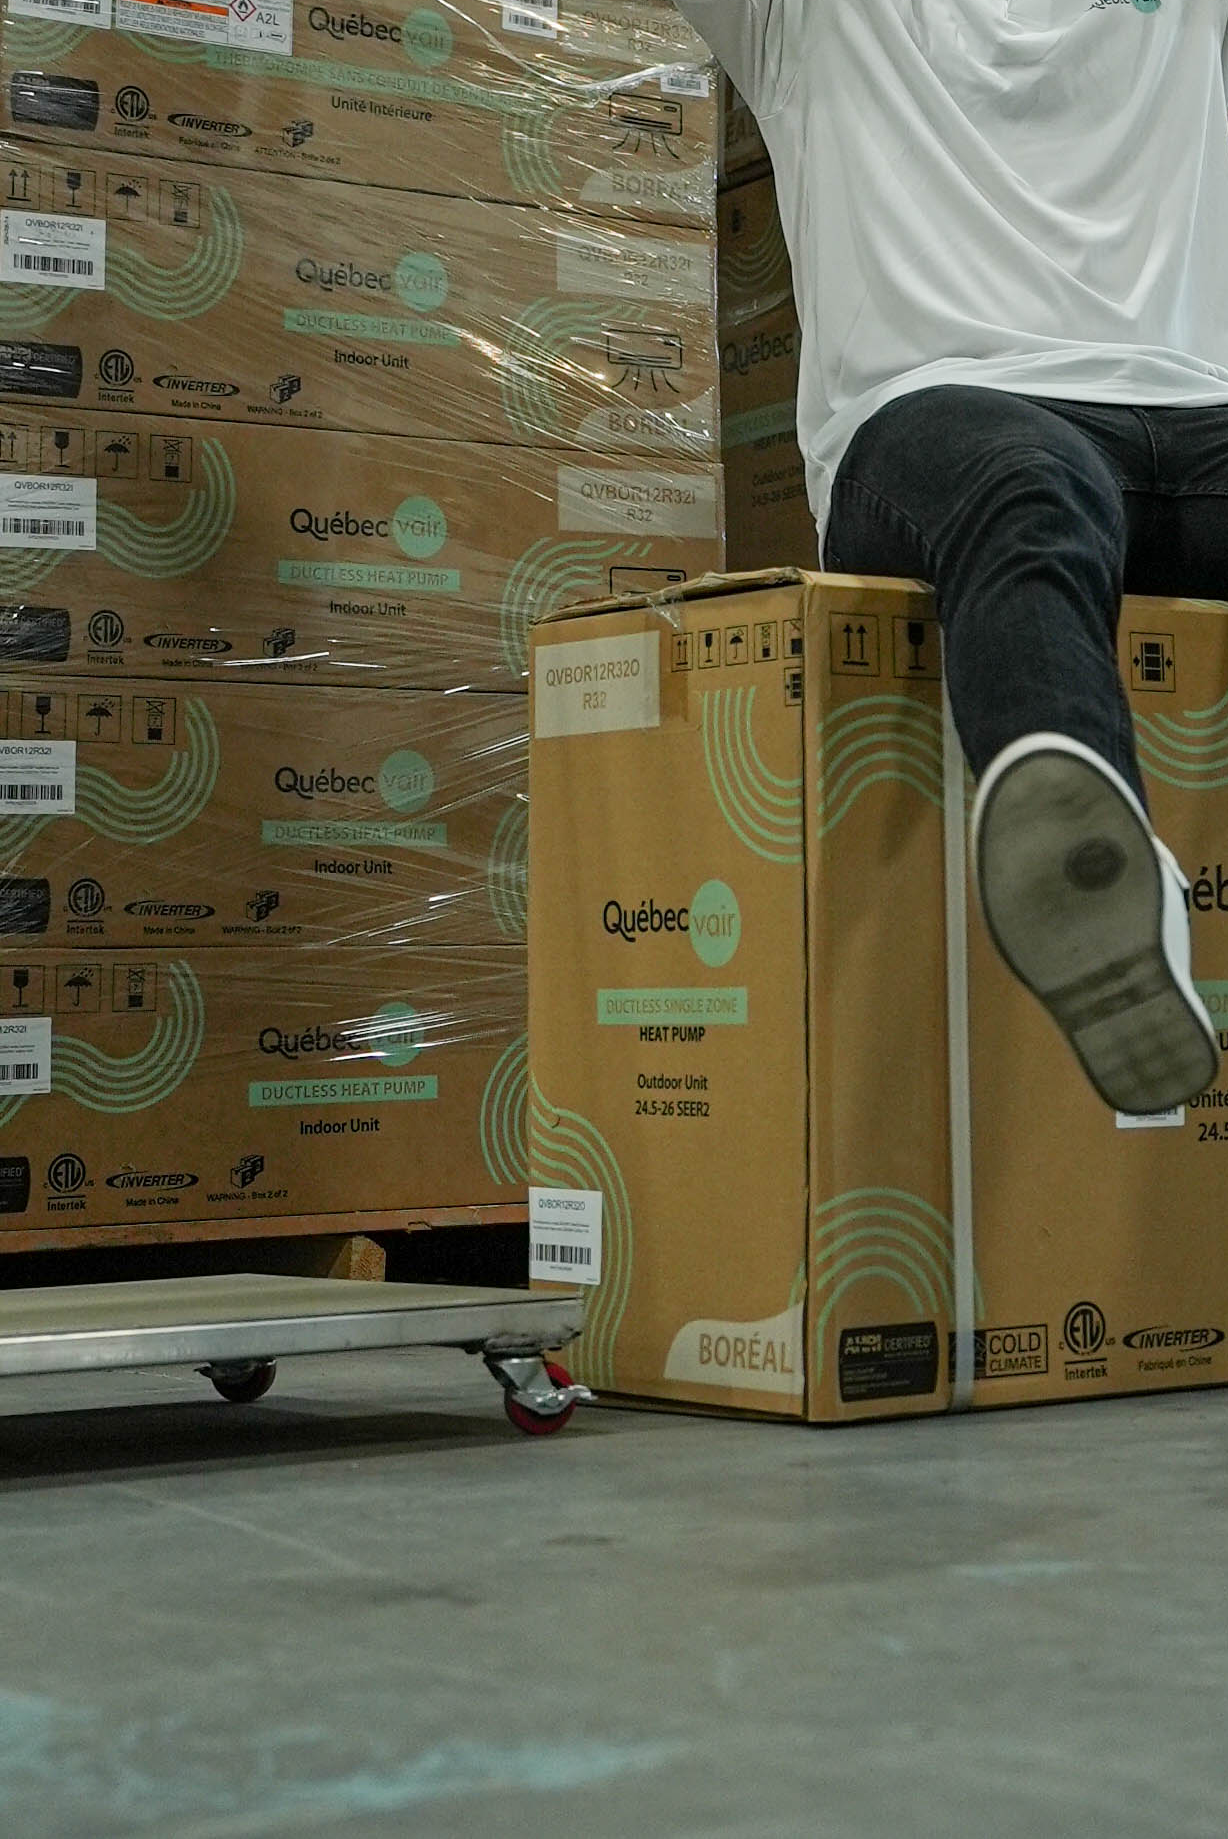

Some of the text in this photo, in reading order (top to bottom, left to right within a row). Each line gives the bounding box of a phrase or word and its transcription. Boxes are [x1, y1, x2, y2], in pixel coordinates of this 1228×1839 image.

[255, 12, 280, 28] A2L
[308, 6, 401, 43] Québec
[331, 95, 433, 121] Unité Intérieure
[181, 116, 240, 135] INVERTER
[295, 258, 392, 292] Québec
[334, 349, 410, 371] Indoor Unit
[166, 379, 227, 394] INVERTER
[98, 391, 134, 404] Intertek
[290, 507, 388, 541] Québec
[290, 565, 449, 587] DUCTLESS HEAT PUMP
[329, 599, 406, 617] Indoor Unit
[157, 637, 218, 652] INVERTER
[582, 691, 607, 711] R32
[0, 746, 52, 756] VBOR12R32I
[274, 765, 375, 799] Québec
[314, 859, 392, 875] Indoor Unit
[139, 904, 201, 916] INVERTER
[603, 898, 736, 944] Québec vair
[606, 996, 738, 1016] DUCTLESS SINGLE ZONE
[639, 1025, 705, 1043] HEAT PUMP
[262, 1080, 426, 1100] DUCTLESS HEAT PUMP
[637, 1073, 709, 1092] Outdoor Unit
[635, 1099, 710, 1118] 24.5-26 SEER2
[300, 1117, 381, 1136] Indoor Unit
[120, 1173, 185, 1188] INVERTER
[48, 1199, 86, 1212] Intertek
[126, 1197, 147, 1207] Made
[157, 1195, 179, 1206] China
[989, 1332, 1042, 1355] COLD
[1139, 1328, 1209, 1349] INVERTER
[698, 1328, 795, 1374] BORÉAL
[989, 1355, 1042, 1372] CLIMATE
[1065, 1364, 1108, 1381] Intertek
